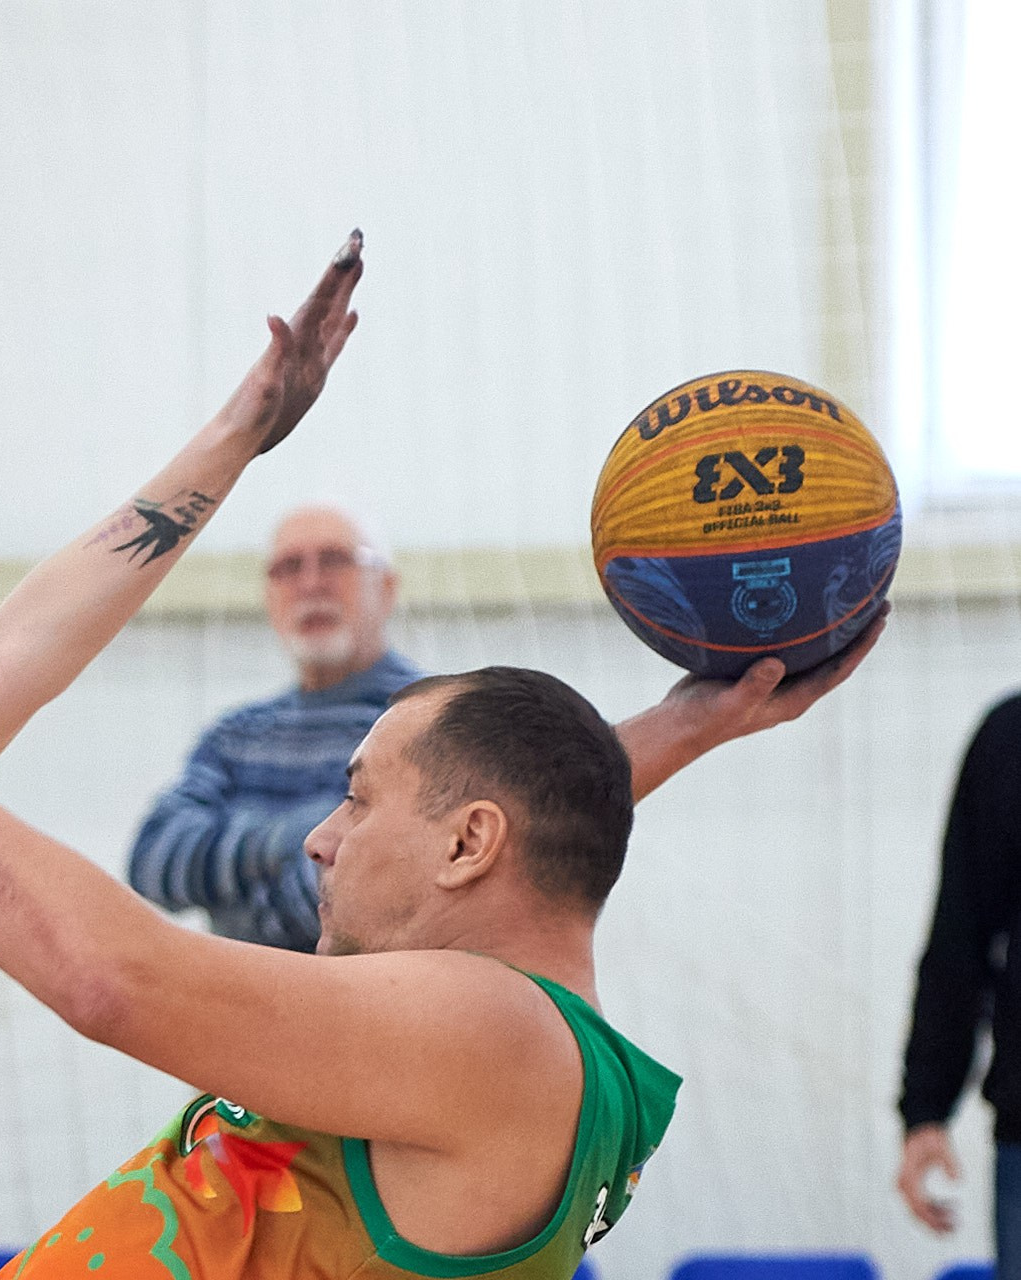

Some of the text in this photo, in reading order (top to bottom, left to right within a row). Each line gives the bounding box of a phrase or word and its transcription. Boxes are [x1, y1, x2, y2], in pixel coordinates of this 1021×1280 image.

[634, 379, 842, 440] Wilson
[702, 512, 800, 534] OFFICIAL BALL
